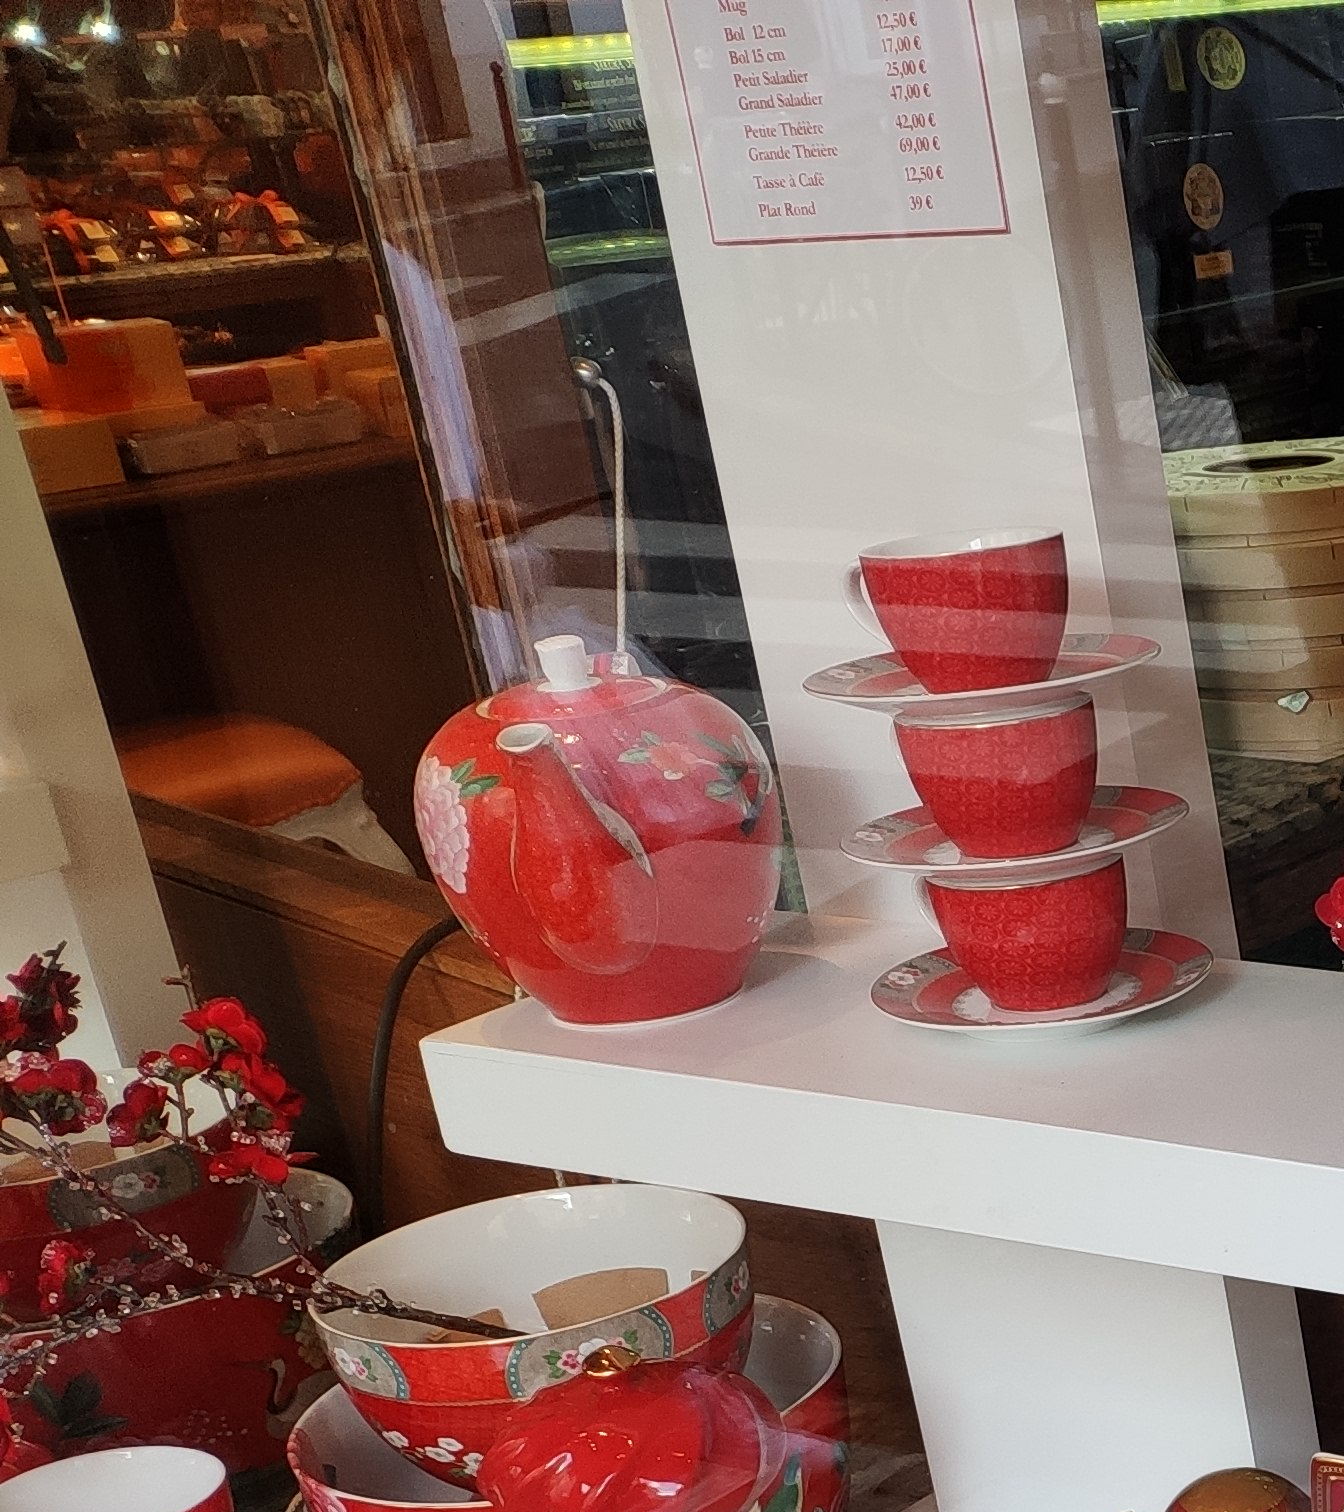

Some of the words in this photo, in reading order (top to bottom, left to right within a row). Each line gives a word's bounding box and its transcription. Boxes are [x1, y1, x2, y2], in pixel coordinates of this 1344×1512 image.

[724, 27, 746, 42] Bol
[752, 25, 766, 39] 12
[768, 26, 786, 39] cm
[877, 12, 907, 30] 12,50
[909, 11, 917, 26] €
[729, 50, 750, 65] Bol
[751, 49, 765, 63] 15
[766, 53, 786, 62] cm
[881, 36, 911, 55] 17,00
[914, 35, 922, 50] €
[734, 72, 761, 88] Petit
[763, 70, 809, 86] Saladier
[885, 60, 916, 79] 25,00
[919, 59, 927, 74] €
[738, 95, 775, 111] Grand
[777, 92, 823, 108] Saladier
[890, 84, 920, 102] 47,00
[923, 83, 931, 98] €
[744, 124, 777, 139] Petite
[779, 121, 824, 137] Théière
[896, 113, 926, 131] 42,00
[928, 112, 936, 127] €
[748, 146, 791, 161] Grande
[792, 143, 839, 159] Théière
[900, 137, 930, 155] 69,00
[932, 136, 940, 151] €
[753, 175, 786, 190] Tasse
[789, 174, 797, 188] à
[799, 172, 825, 187] Café
[905, 166, 934, 184] 12,50
[936, 165, 944, 179] €
[758, 203, 782, 218] Plat
[784, 201, 816, 216] Rond
[909, 195, 923, 211] 39
[925, 195, 934, 210] €
